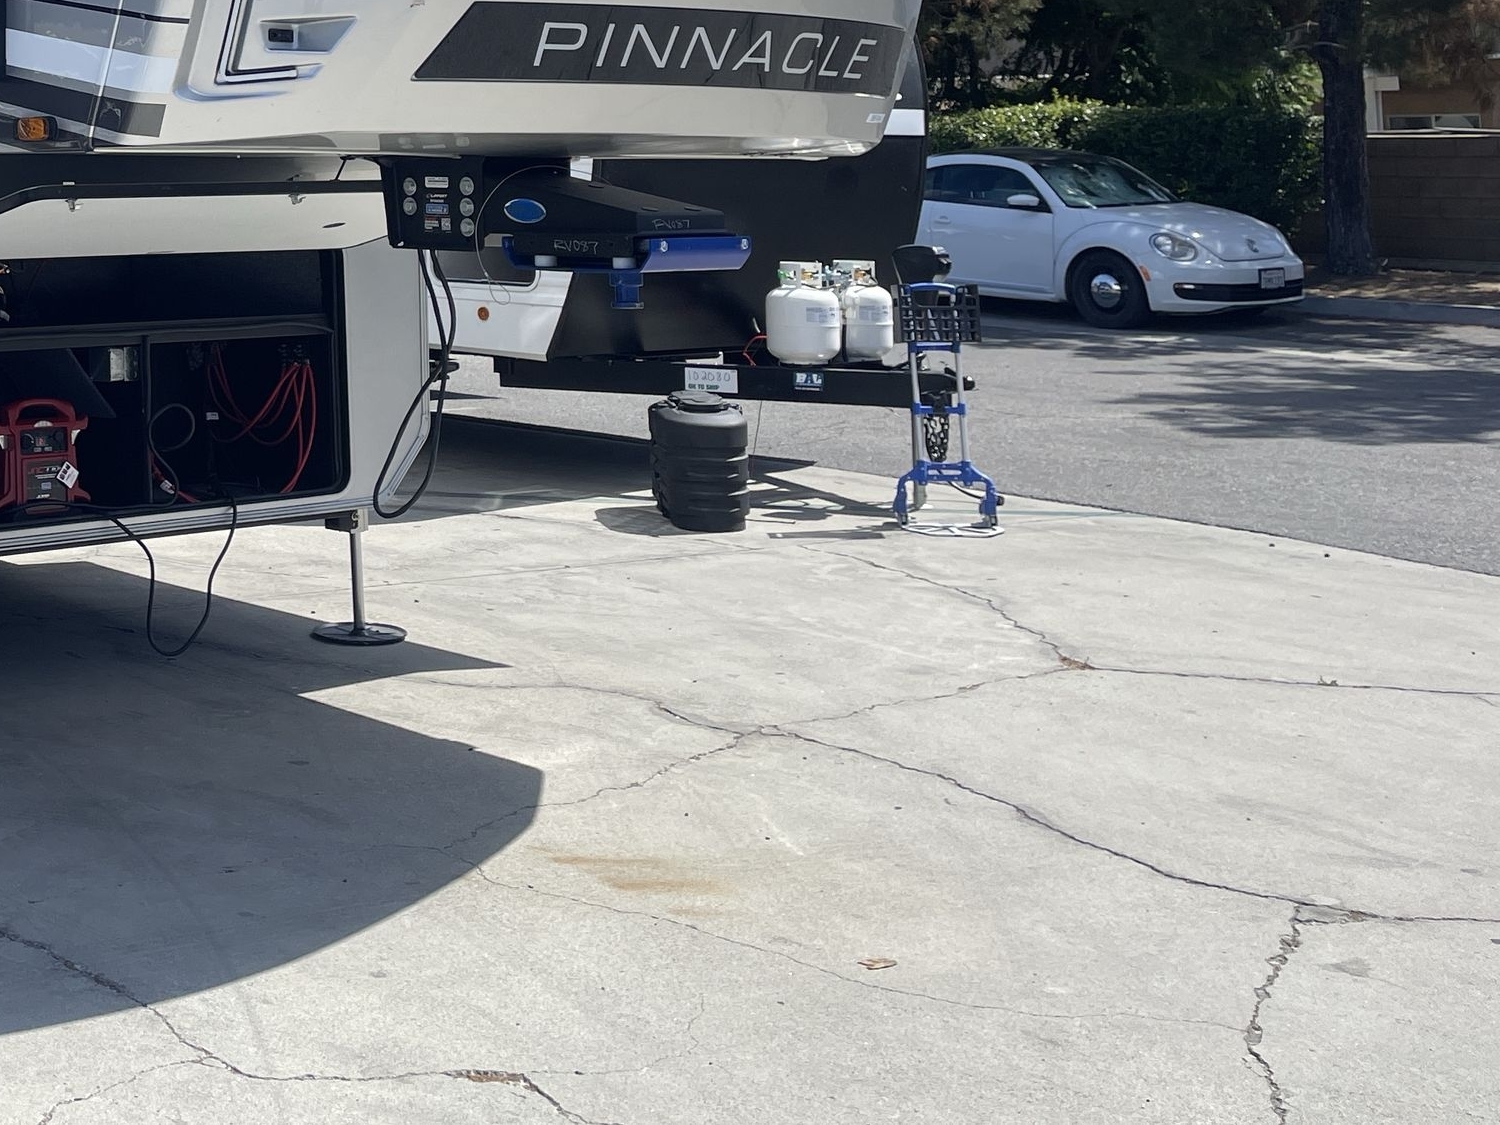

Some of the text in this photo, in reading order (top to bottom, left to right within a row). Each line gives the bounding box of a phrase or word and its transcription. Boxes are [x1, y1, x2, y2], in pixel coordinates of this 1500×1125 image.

[533, 21, 878, 79] PINNACLE
[652, 218, 692, 230] RV087
[553, 239, 599, 255] RV087
